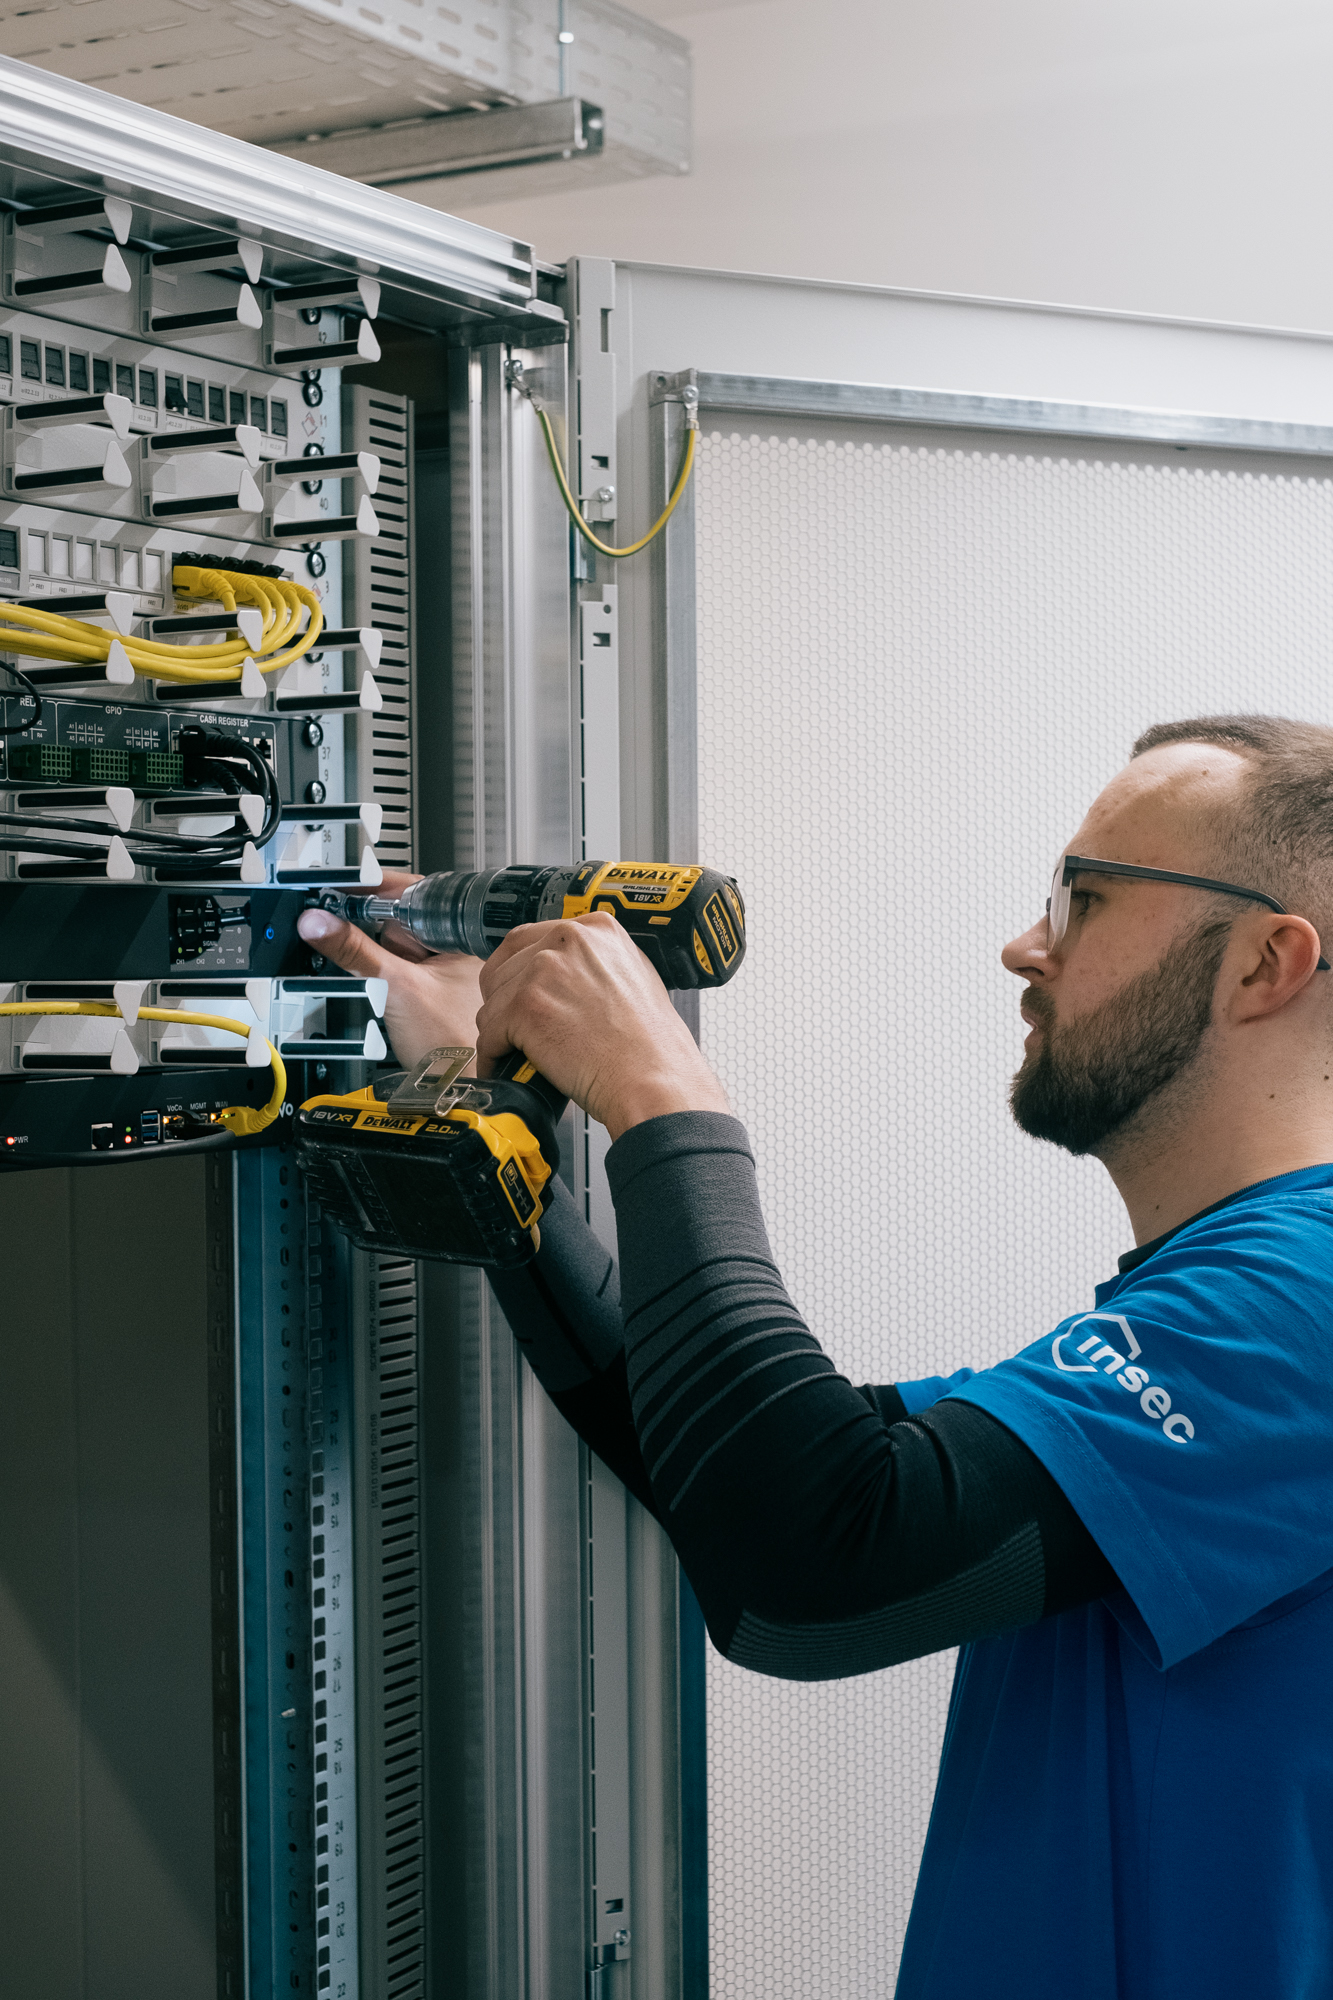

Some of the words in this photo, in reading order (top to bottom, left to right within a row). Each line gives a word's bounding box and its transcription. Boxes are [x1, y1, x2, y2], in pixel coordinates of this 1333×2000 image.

[321, 662, 330, 677] 38
[105, 705, 122, 715] GPIO
[199, 714, 217, 724] CASH
[218, 716, 249, 727] REGISTER
[321, 746, 331, 760] 37
[322, 829, 332, 843] 36
[622, 884, 668, 892] BRUSHLESS
[633, 893, 650, 903] 18V
[649, 894, 663, 904] XR
[711, 903, 733, 953] BRUSHLESS
[712, 916, 727, 949] MOTOR
[166, 1104, 183, 1112] VoCo
[189, 1101, 207, 1110] MGMT
[312, 1110, 337, 1122] 18V
[335, 1113, 354, 1123] XR
[13, 1135, 29, 1143] PWR
